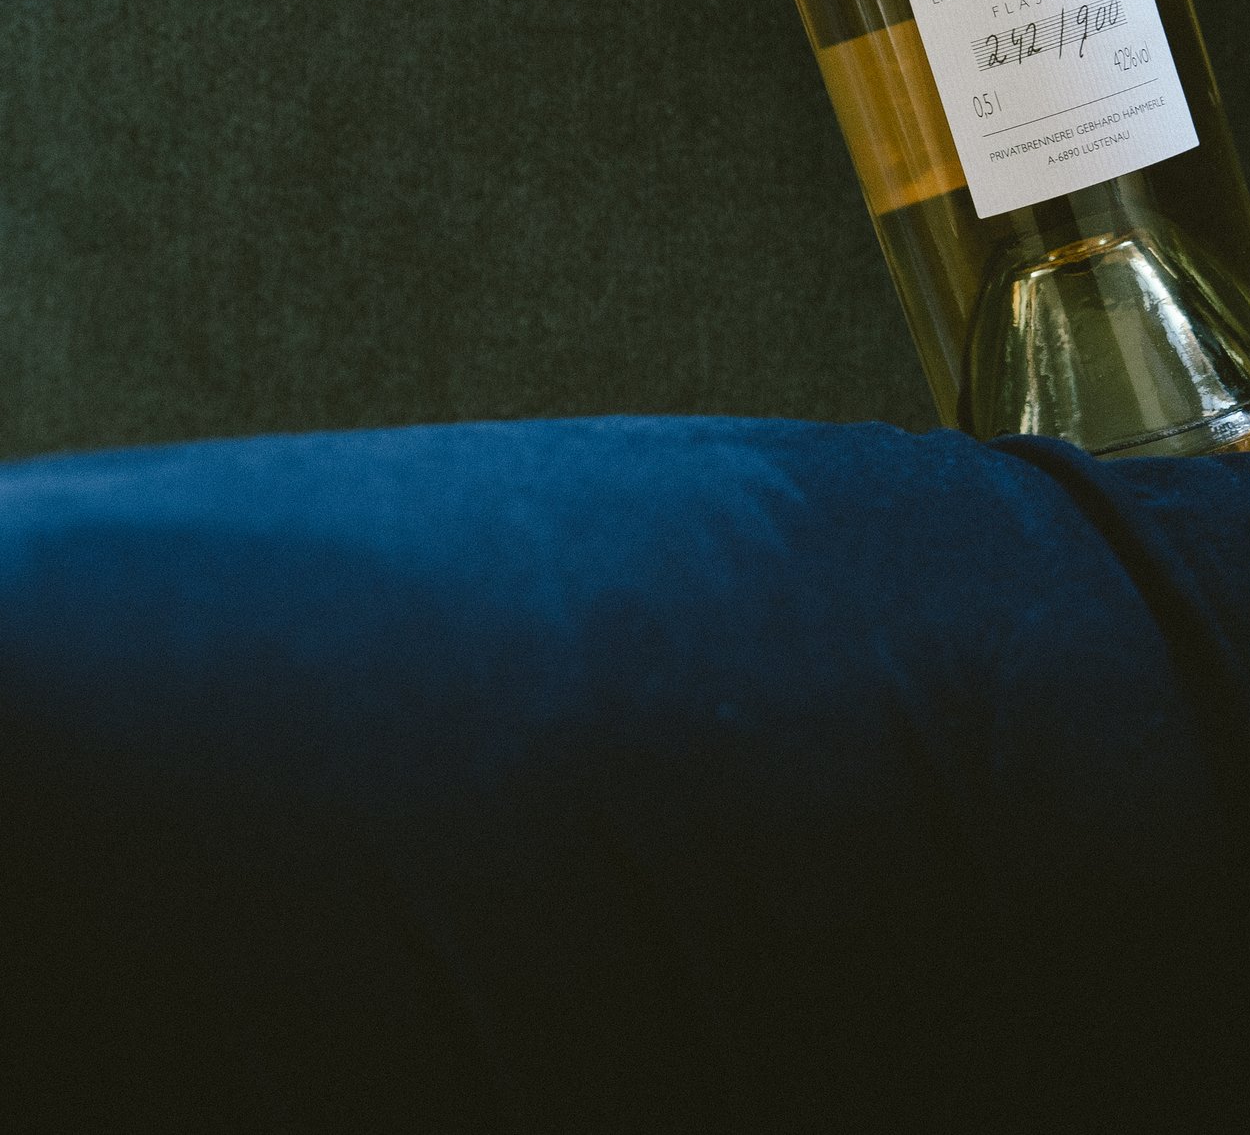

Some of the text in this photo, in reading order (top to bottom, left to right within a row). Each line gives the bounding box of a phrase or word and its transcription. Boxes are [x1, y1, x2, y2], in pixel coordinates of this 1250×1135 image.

[985, 22, 1042, 66] 242
[972, 93, 994, 118] 0,5
[989, 95, 1166, 162] PRIVATBRENNEREI GEBHARD HÄMMERLE
[1047, 129, 1131, 166] A-6890 LUSTENAU
